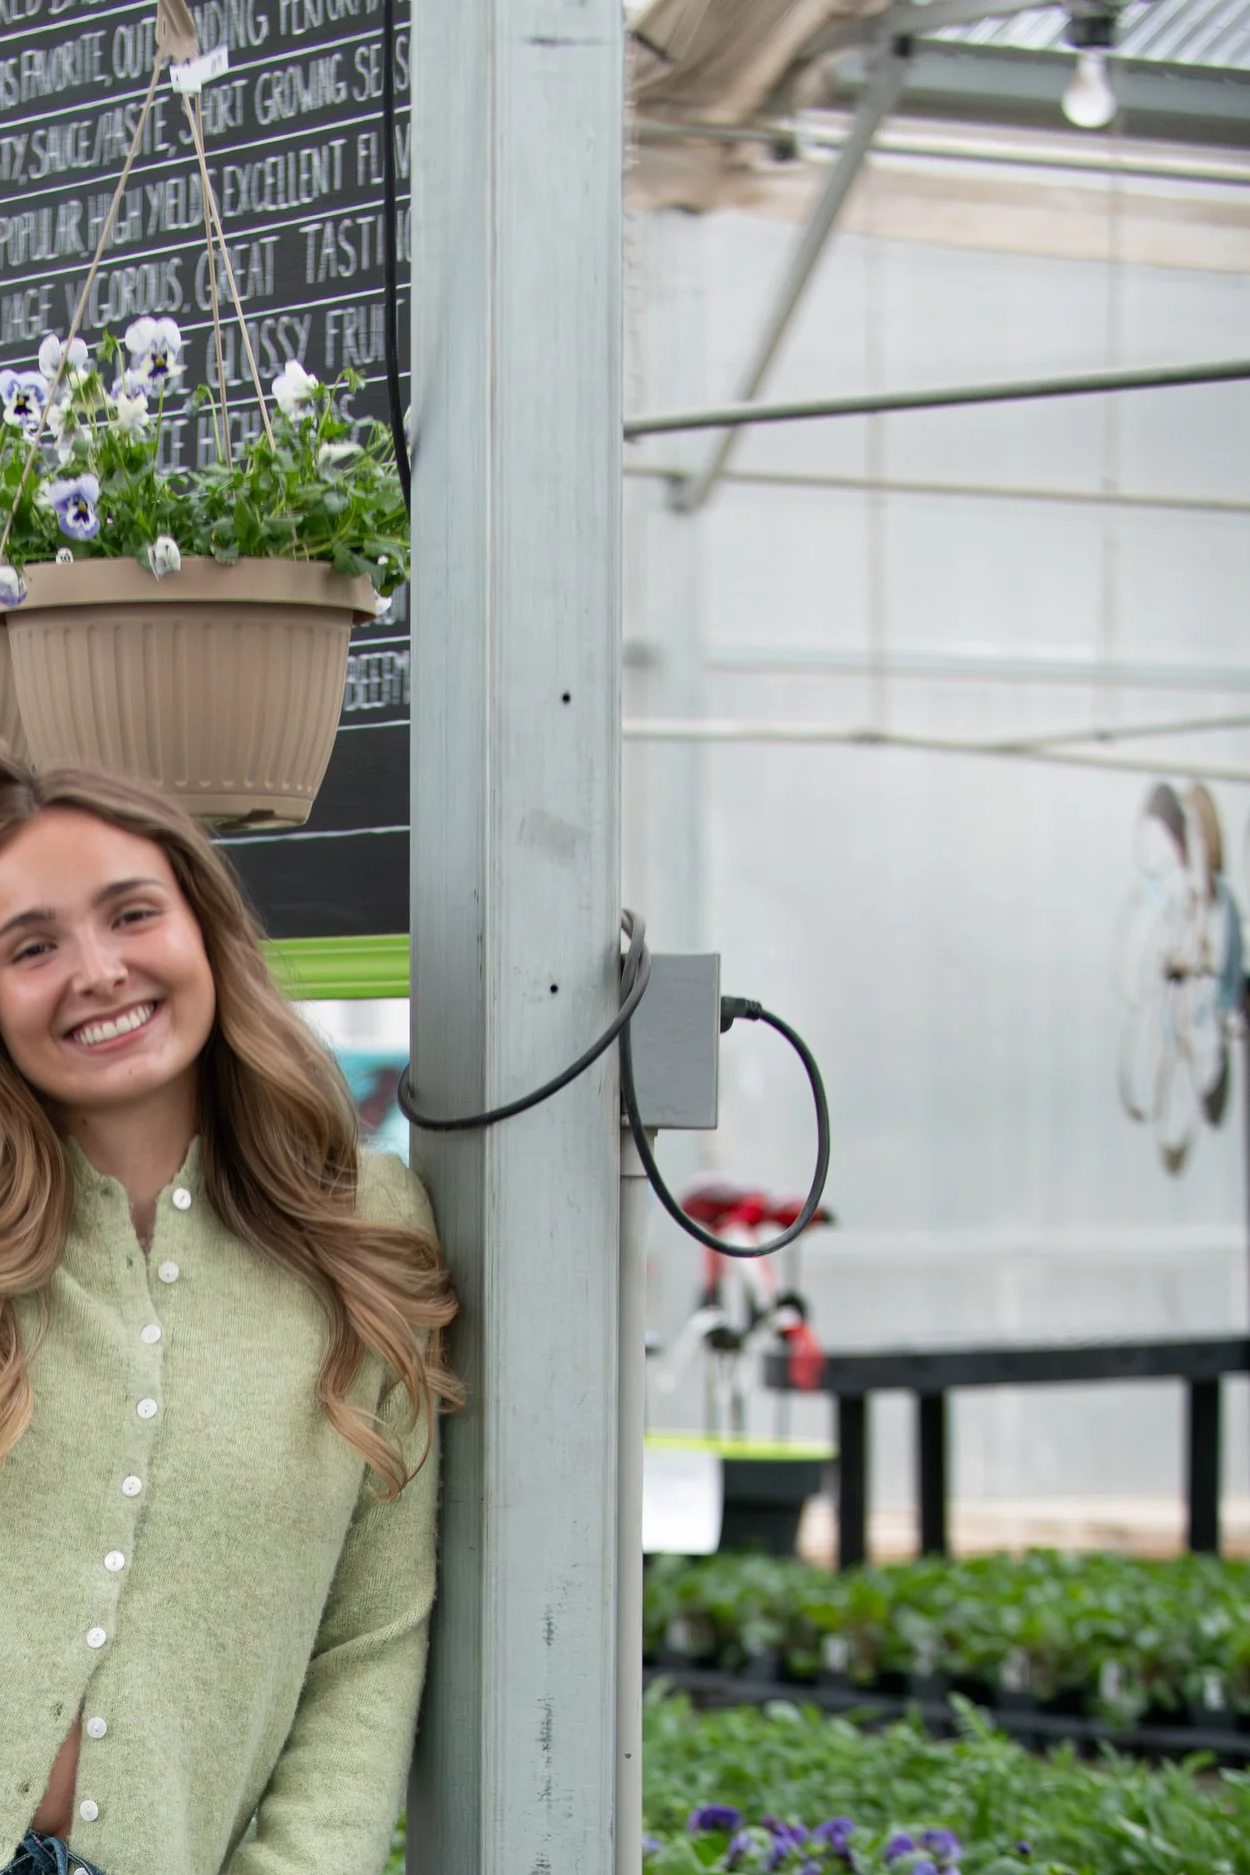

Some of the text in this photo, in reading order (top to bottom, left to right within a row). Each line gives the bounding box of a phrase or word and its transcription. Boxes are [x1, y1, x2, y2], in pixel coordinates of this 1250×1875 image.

[112, 0, 269, 79] OUTNDING
[254, 53, 348, 125] GROWING
[222, 138, 348, 217] EXCELLENT
[356, 123, 411, 187] FLV
[194, 236, 281, 311] GREAT
[324, 298, 405, 370] FRUI
